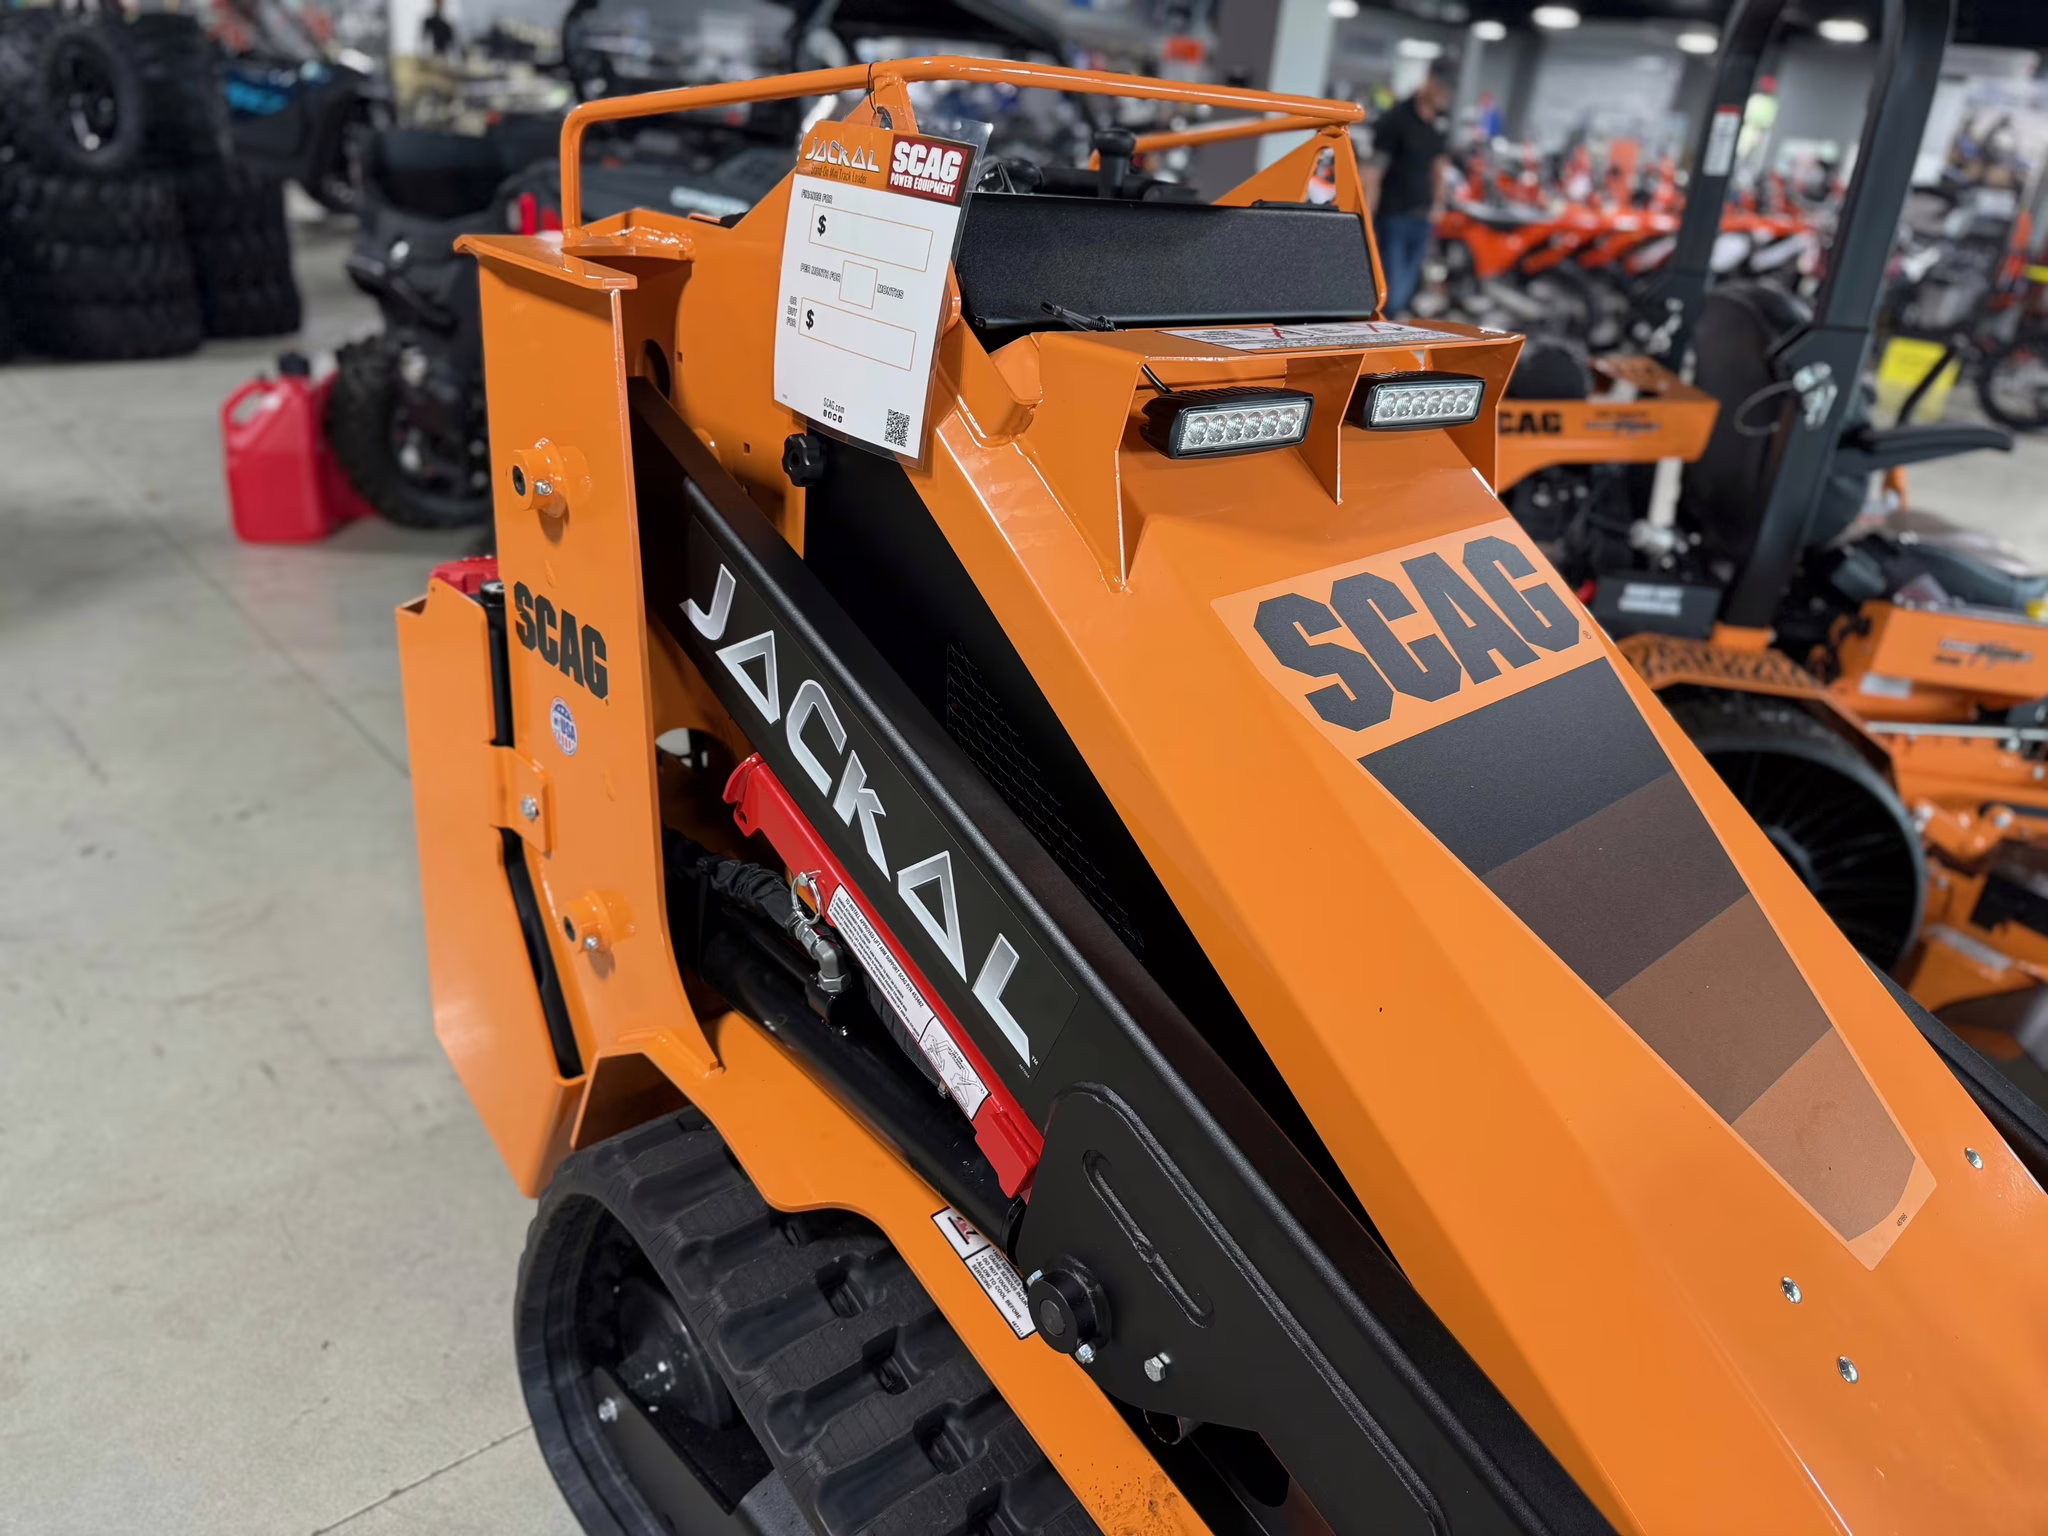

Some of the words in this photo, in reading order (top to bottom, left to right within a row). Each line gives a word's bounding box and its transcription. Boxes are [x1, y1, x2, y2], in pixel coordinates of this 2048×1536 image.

[805, 137, 880, 173] JACKAL
[892, 141, 962, 182] SCAG
[840, 170, 851, 181] Track
[852, 172, 867, 184] Loader
[890, 172, 913, 188] POWER
[914, 177, 955, 197] EQUIPMENT
[817, 215, 826, 236] $
[800, 263, 810, 274] PER
[811, 266, 829, 279] MONTH
[830, 271, 841, 282] FOR
[877, 284, 904, 299] MONTHS
[806, 309, 815, 330] $
[823, 398, 844, 413] SCAG.com
[514, 581, 608, 699] SCAG
[1254, 536, 1579, 731] SCAG
[560, 717, 576, 743] USA
[680, 564, 1030, 1067] JACKAL
[849, 904, 860, 919] INSTALL
[859, 919, 874, 938] APPROVED
[873, 937, 881, 947] LIFT
[879, 946, 887, 956] ARM
[886, 955, 900, 973] SUPPORT
[898, 972, 907, 984] SCAG
[972, 1264, 991, 1289] SERVICING
[989, 1254, 1002, 1270] CAUSE
[1001, 1271, 1017, 1291] SERIOUS
[989, 1265, 998, 1276] NOT
[997, 1276, 1011, 1293] TOUCH
[993, 1251, 1003, 1261] HOT
[1001, 1262, 1021, 1286] SURFACES
[977, 1262, 991, 1277] ALLOW
[989, 1277, 996, 1285] TO
[995, 1285, 1006, 1299] COOL
[1005, 1299, 1021, 1319] BEFORE
